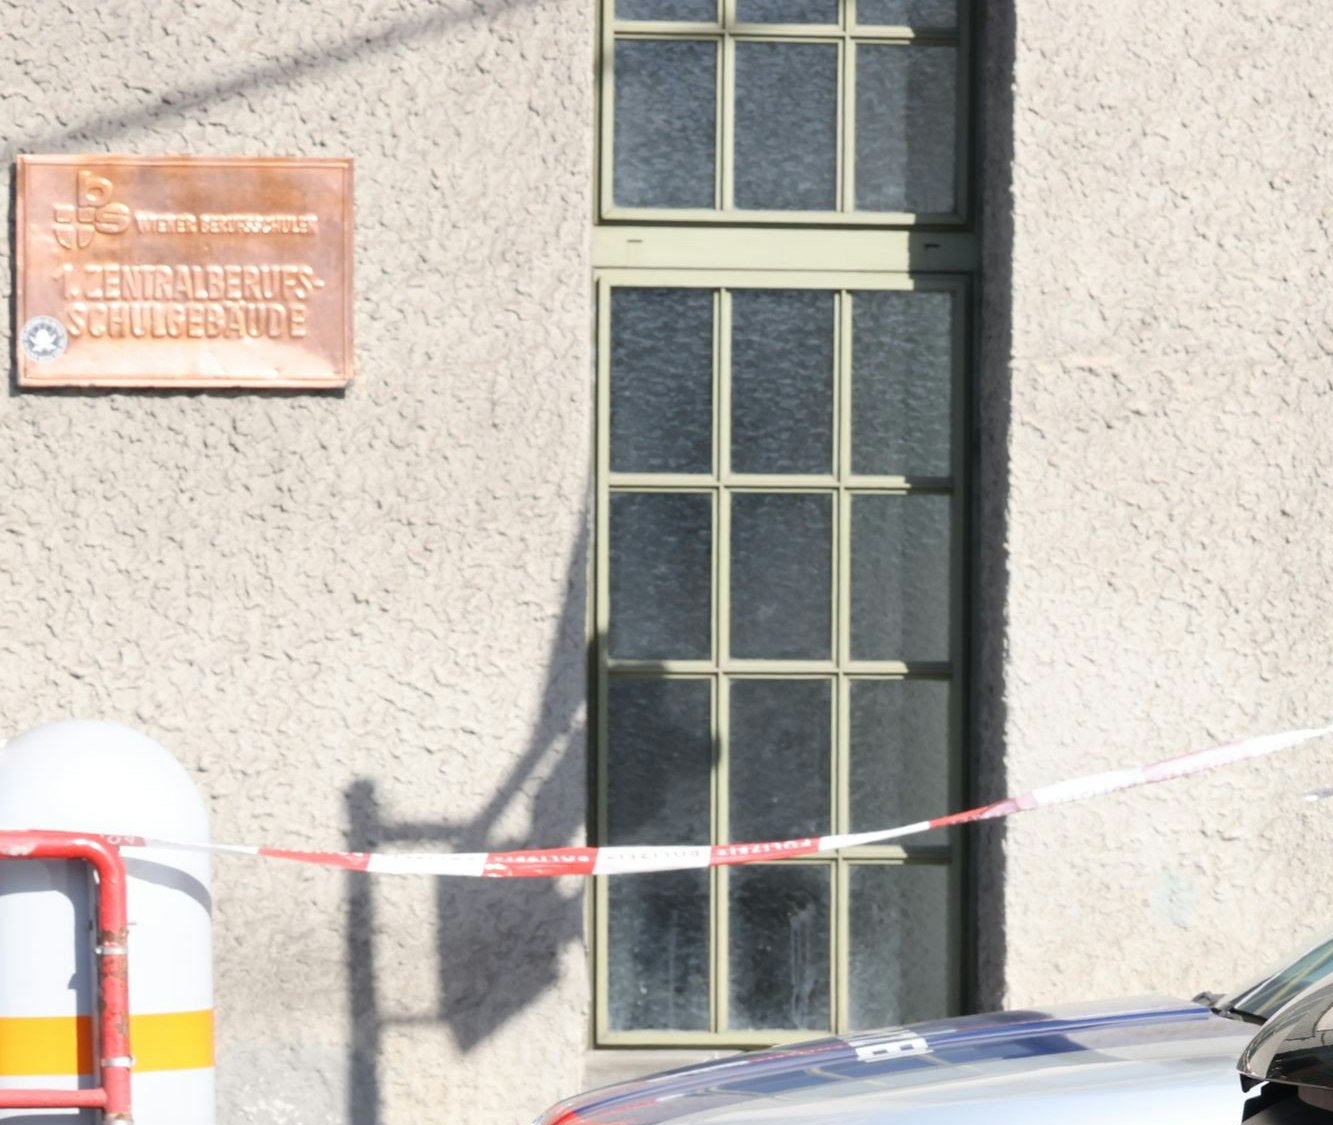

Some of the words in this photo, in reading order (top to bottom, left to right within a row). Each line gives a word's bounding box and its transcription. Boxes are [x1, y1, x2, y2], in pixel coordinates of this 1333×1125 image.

[134, 209, 197, 234] WIENER
[199, 212, 319, 236] BERUFSSCHULEN
[83, 263, 326, 301] ZENTRALBERUFS-
